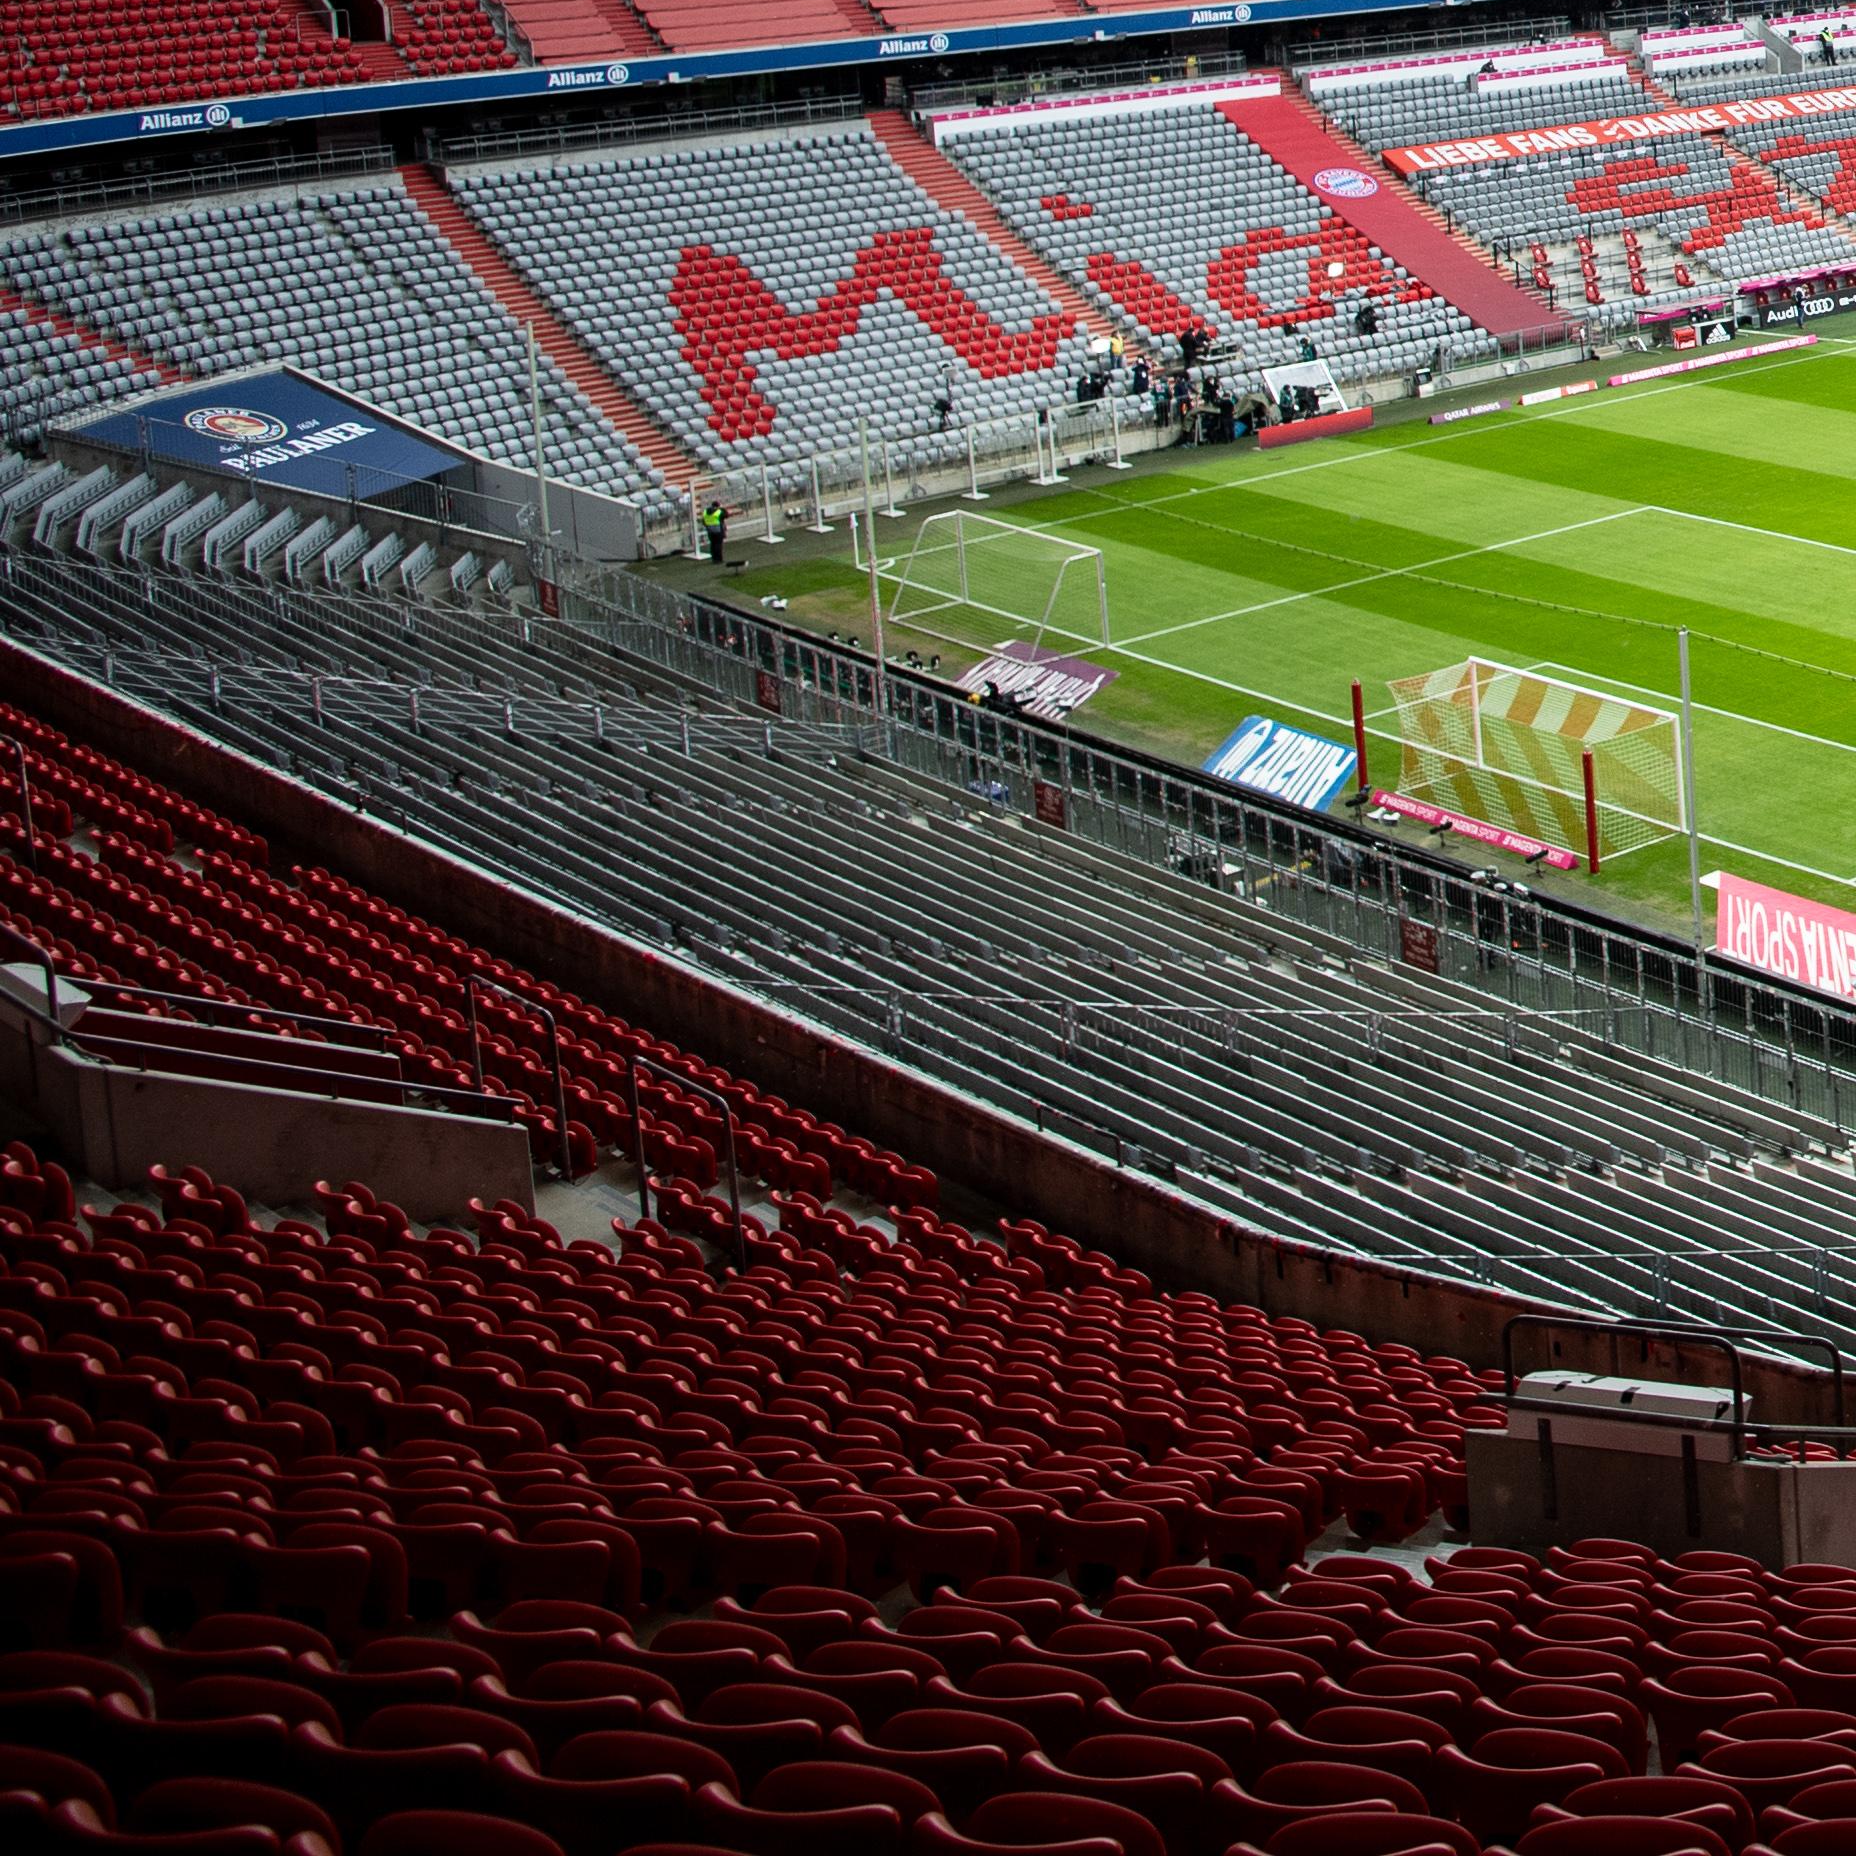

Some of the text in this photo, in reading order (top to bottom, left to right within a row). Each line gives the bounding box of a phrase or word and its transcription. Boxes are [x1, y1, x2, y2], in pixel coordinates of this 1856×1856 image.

[1191, 7, 1233, 24] Allianz
[879, 38, 929, 55] Allianz
[548, 67, 605, 88] Allianz
[140, 109, 204, 132] Allianz
[1404, 137, 1502, 169] LIEBE
[1507, 126, 1598, 159] FANS
[1620, 108, 1720, 138] DANKE
[1725, 95, 1787, 124] FÜR
[1766, 304, 1799, 323] Audi
[1705, 333, 1731, 345] adidas
[1443, 408, 1468, 421] QATAR
[219, 422, 377, 472] PAULANER
[1238, 726, 1358, 810] Allianz
[1722, 894, 1799, 979] SPORT
